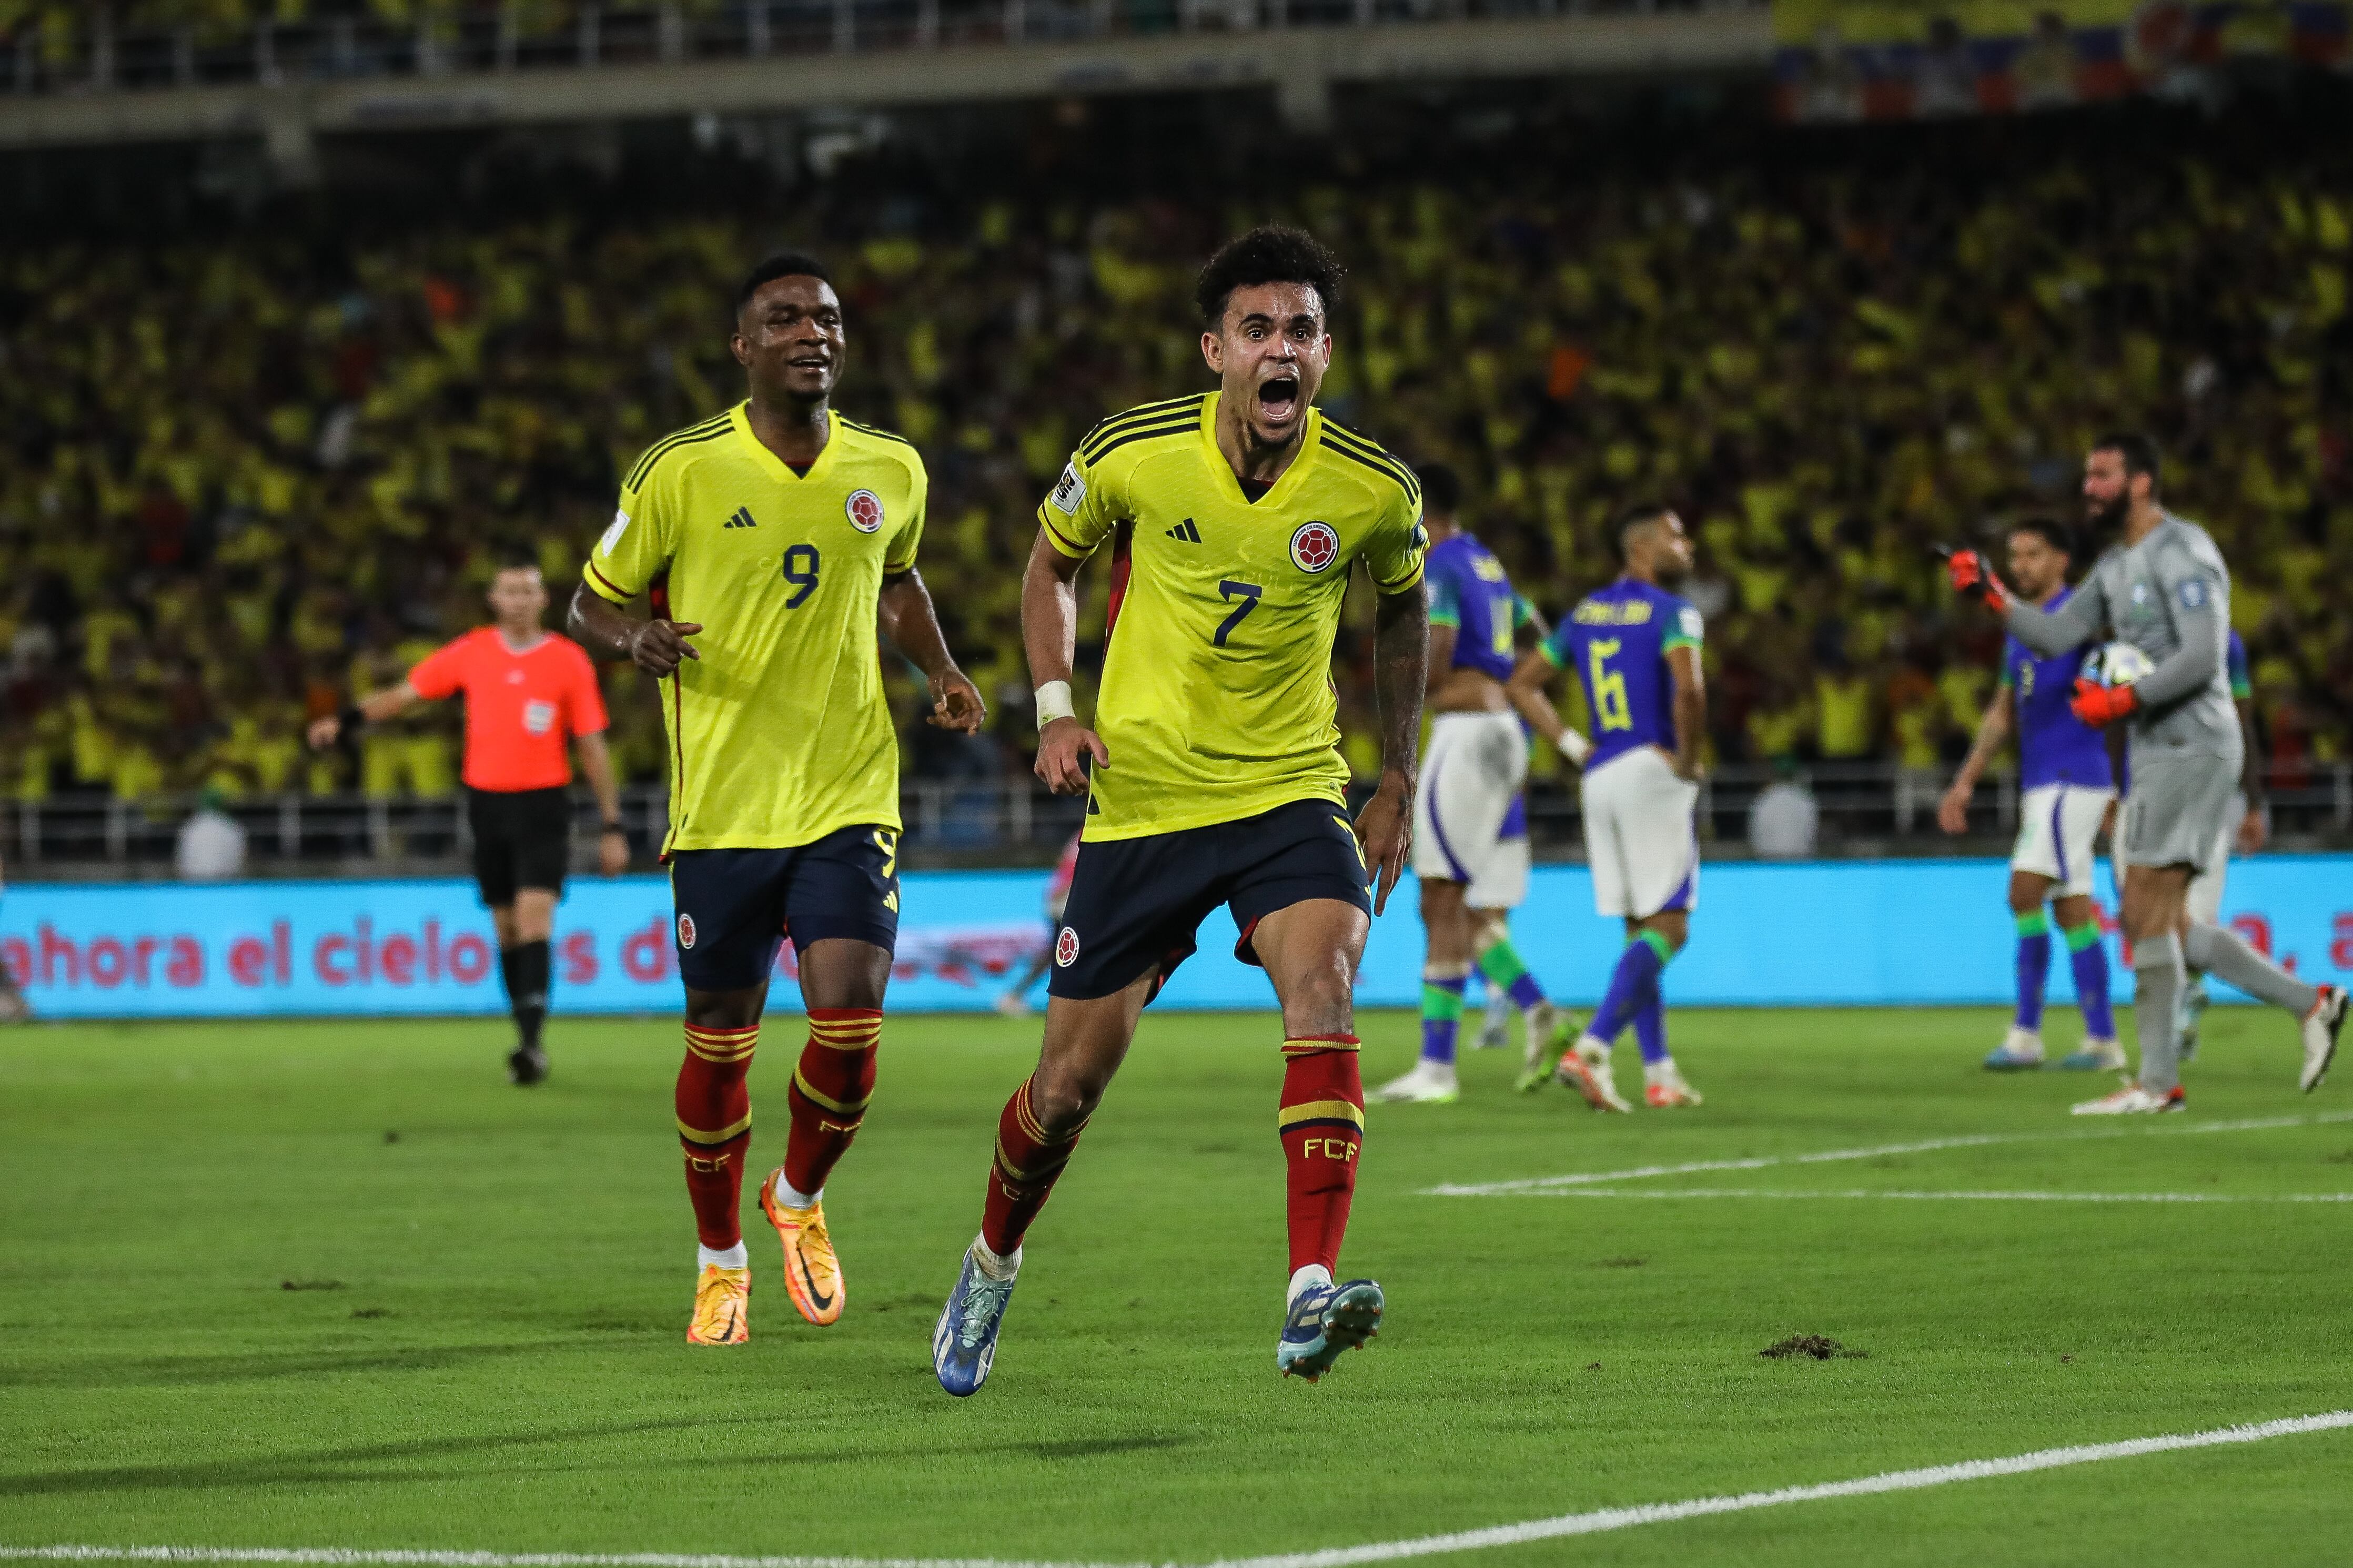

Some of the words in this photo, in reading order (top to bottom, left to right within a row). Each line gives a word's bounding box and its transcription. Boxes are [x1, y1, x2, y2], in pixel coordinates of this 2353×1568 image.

[783, 544, 820, 609] 9
[1213, 580, 1263, 647] 7
[1588, 638, 1632, 731] 6
[227, 920, 290, 986] el
[1304, 1138, 1357, 1162] FCF
